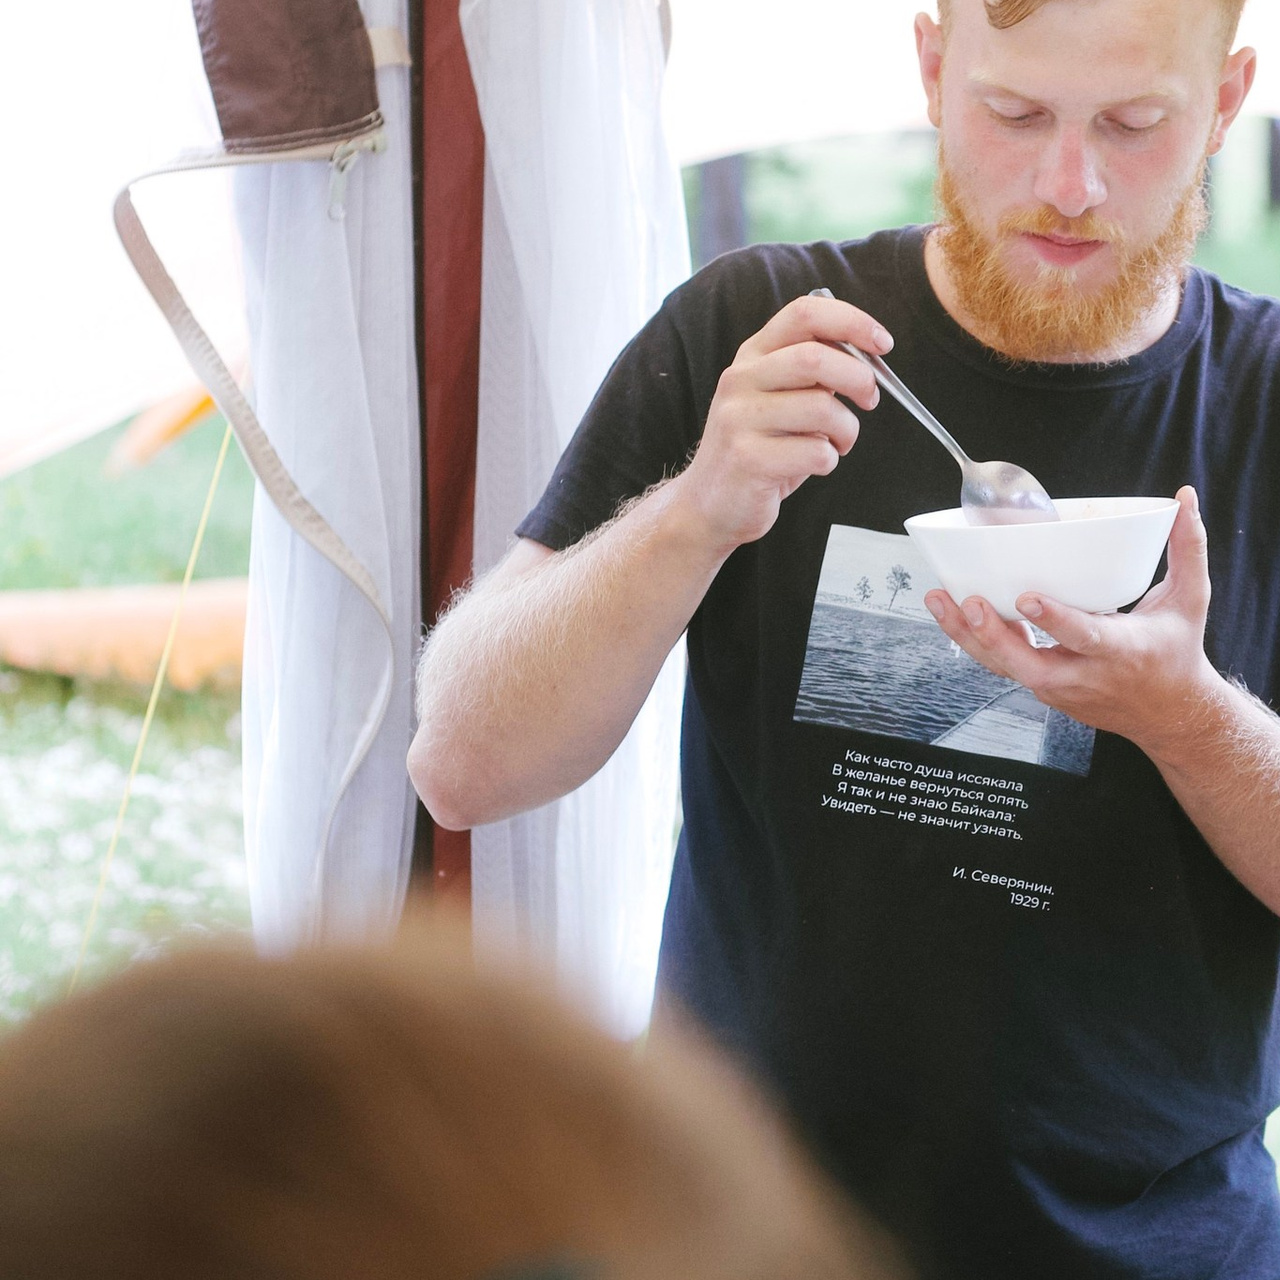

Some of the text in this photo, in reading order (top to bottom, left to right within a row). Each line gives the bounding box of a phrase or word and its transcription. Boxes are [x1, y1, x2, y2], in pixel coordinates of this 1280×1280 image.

[832, 763, 1029, 810] В желанье вернуться опять
[845, 749, 1024, 792] Как часто душа иссякала
[821, 794, 877, 815] Увидеть
[897, 810, 917, 822] не
[919, 814, 971, 831] значит
[971, 823, 1023, 841] узнать.
[837, 781, 1016, 823] Я так и не знаю Байкала:
[952, 866, 1055, 896] И. Северянин.
[1010, 892, 1051, 911] 1929 г.
